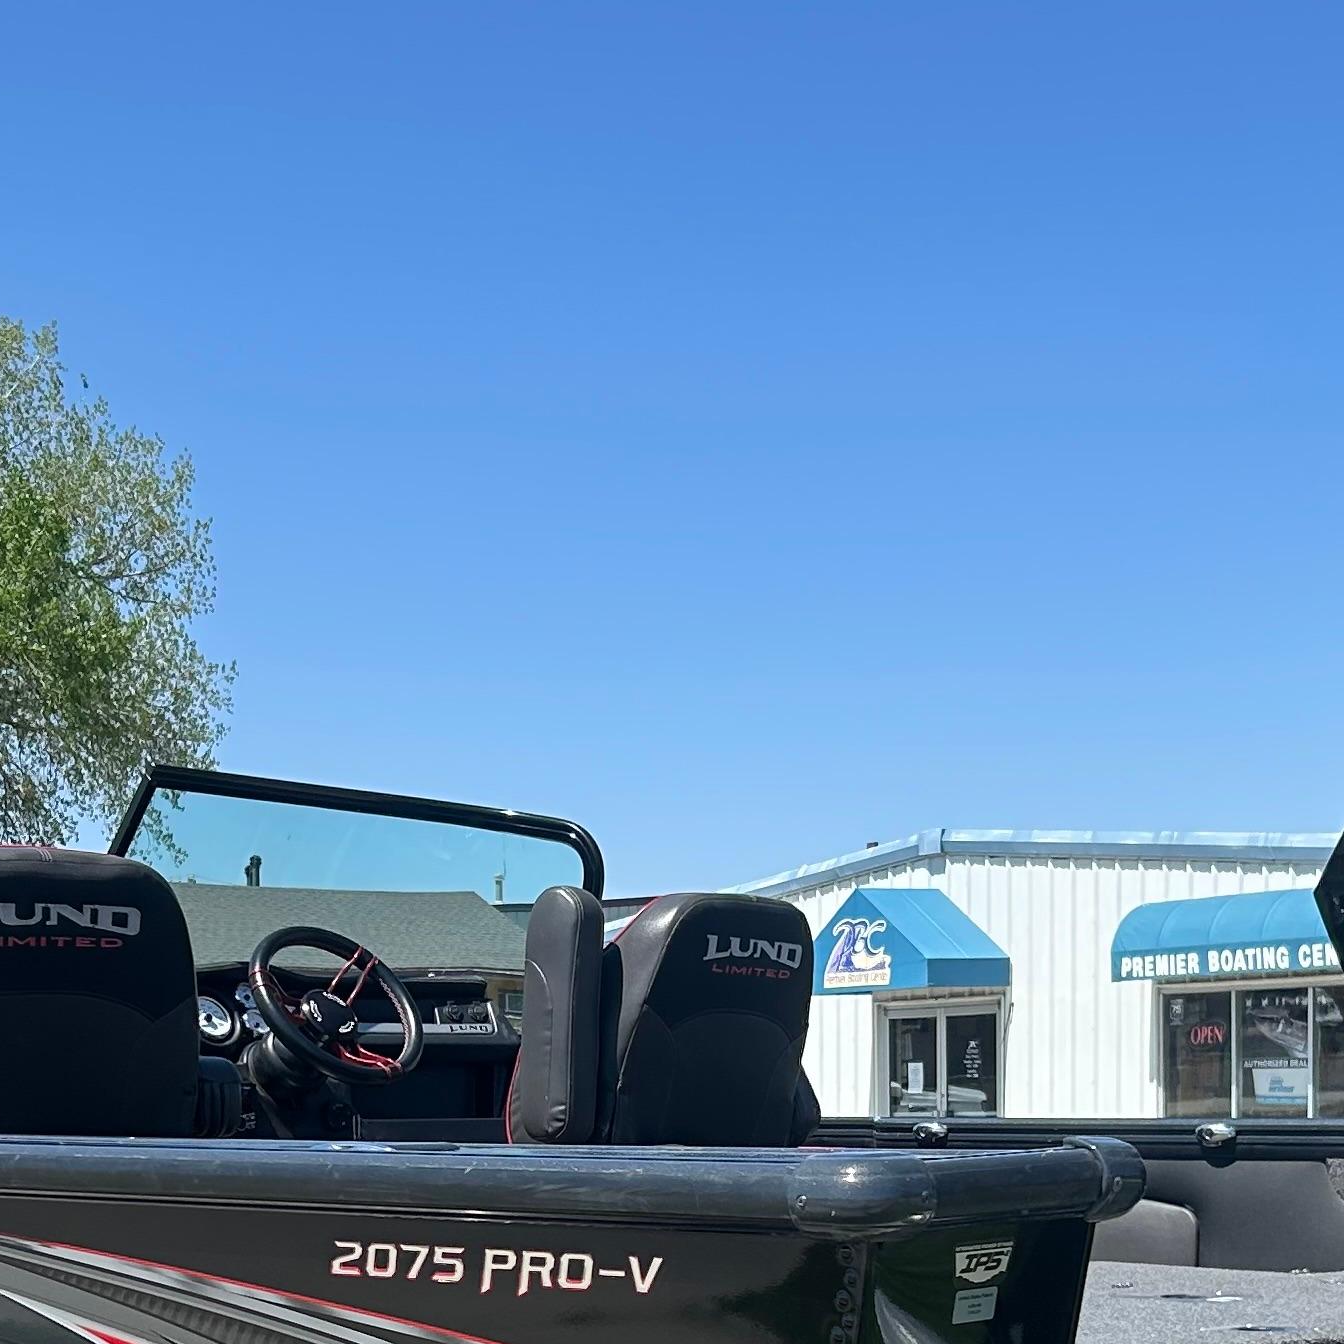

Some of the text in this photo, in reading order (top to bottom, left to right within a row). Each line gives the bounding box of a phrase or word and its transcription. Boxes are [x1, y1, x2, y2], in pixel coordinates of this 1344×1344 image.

[703, 934, 803, 969] LUND
[1120, 953, 1199, 977] PREMIER
[1208, 946, 1290, 973] BOATING
[711, 963, 791, 979] LIMITED
[449, 1025, 489, 1033] LUND
[1191, 1024, 1224, 1046] OPEN
[330, 1240, 663, 1297] 2075 PRO-V
